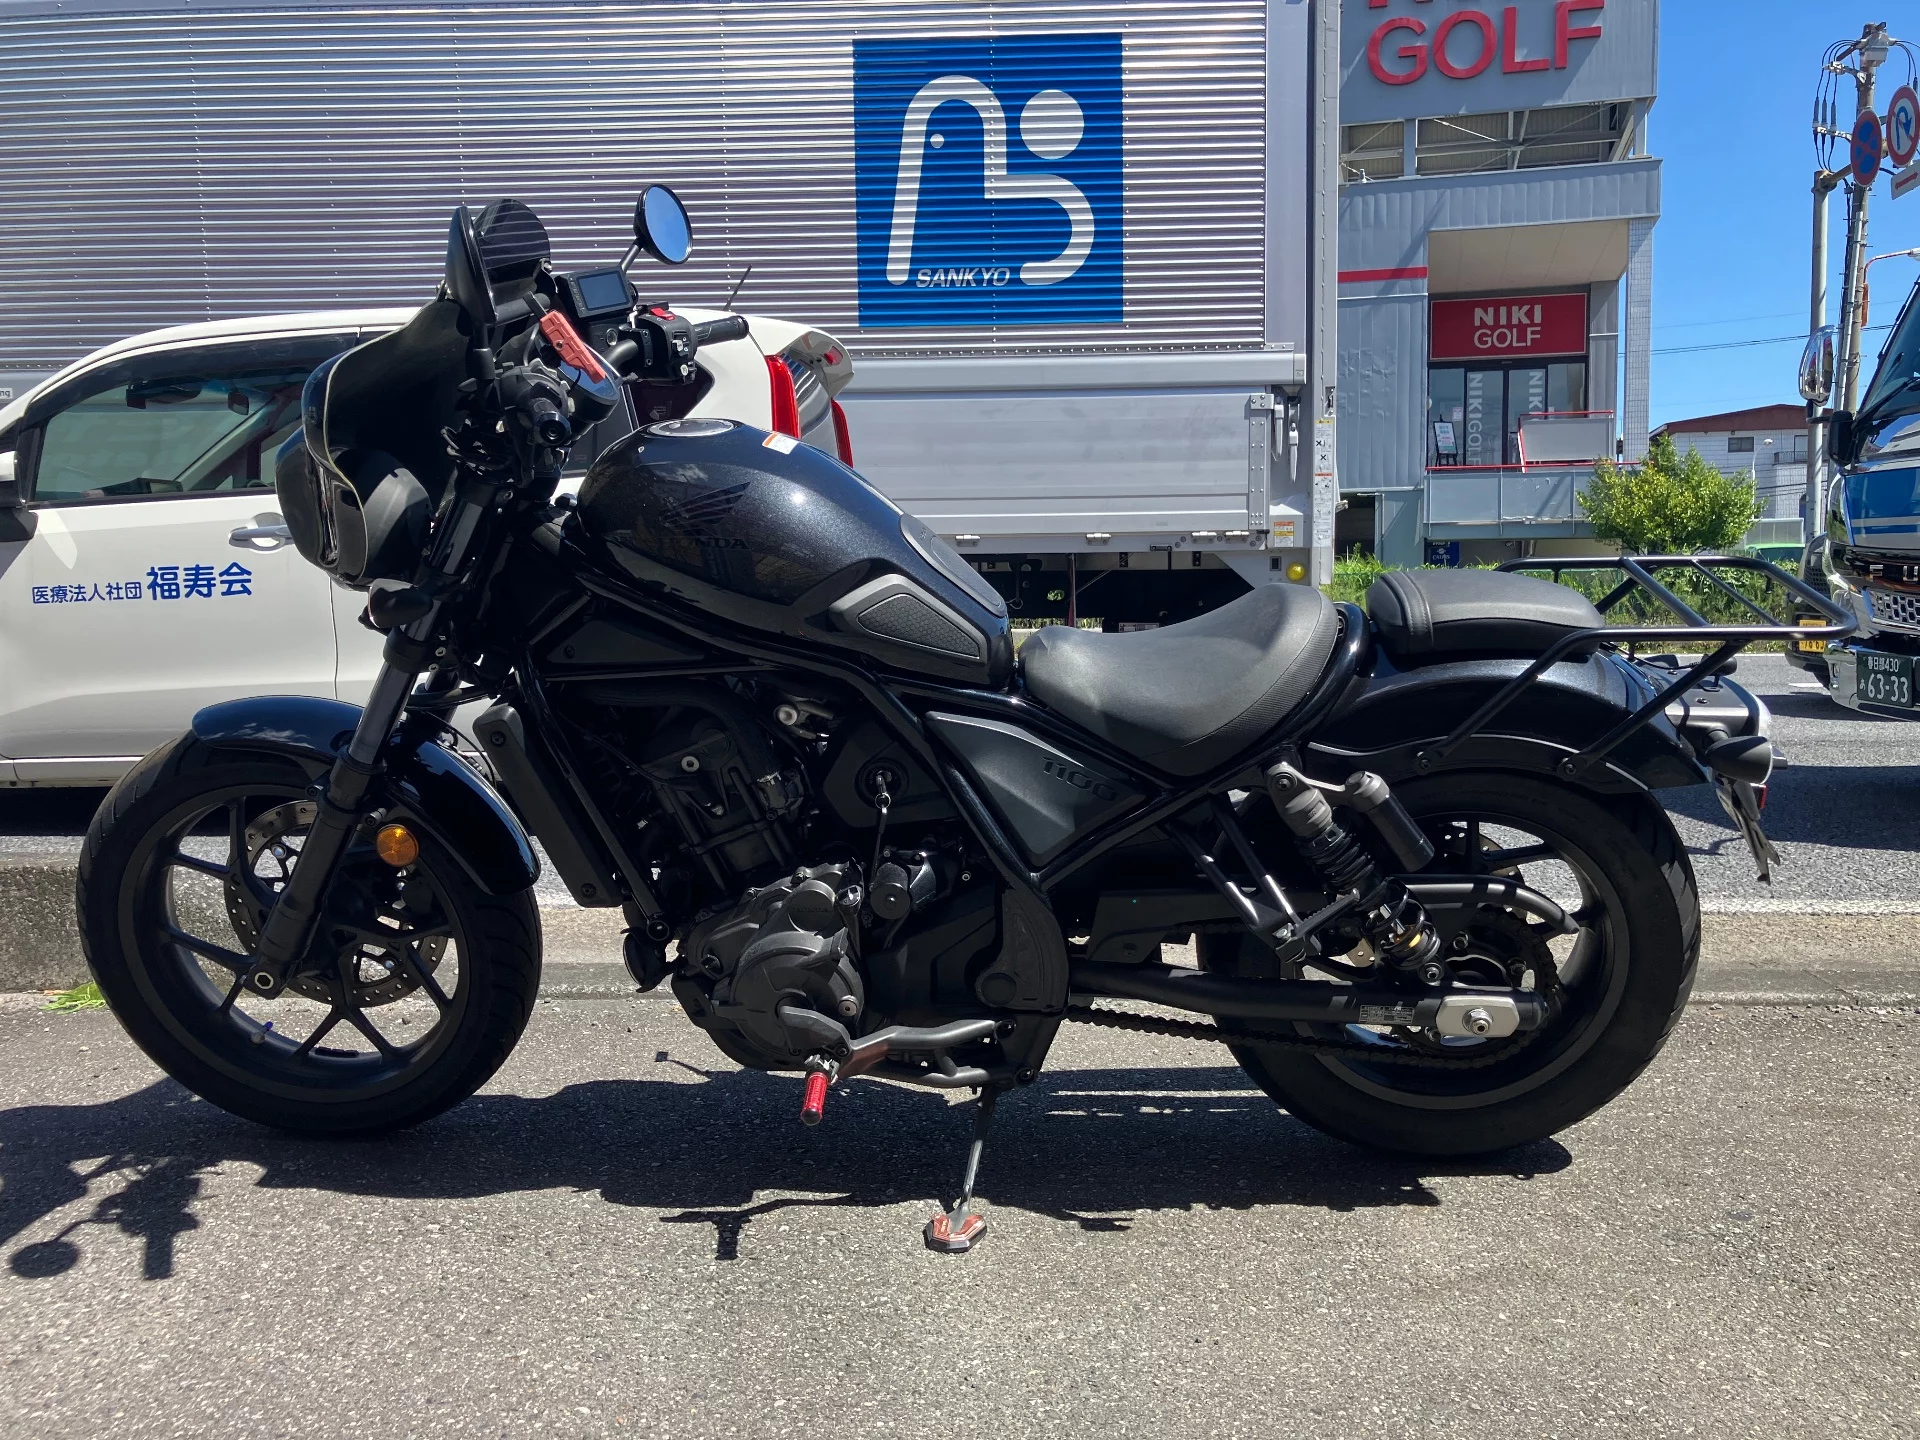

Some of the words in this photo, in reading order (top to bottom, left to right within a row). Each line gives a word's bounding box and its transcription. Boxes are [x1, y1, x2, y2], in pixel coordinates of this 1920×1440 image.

[1367, 0, 1605, 86] GOLF
[915, 267, 1011, 288] SANKYO
[1474, 304, 1542, 327] NIKI
[1473, 326, 1541, 349] GOLF
[32, 581, 142, 604] 医療法人社団
[145, 561, 253, 601] 福寿会
[1867, 672, 1909, 704] 63-33
[1042, 756, 1119, 802] 1100
